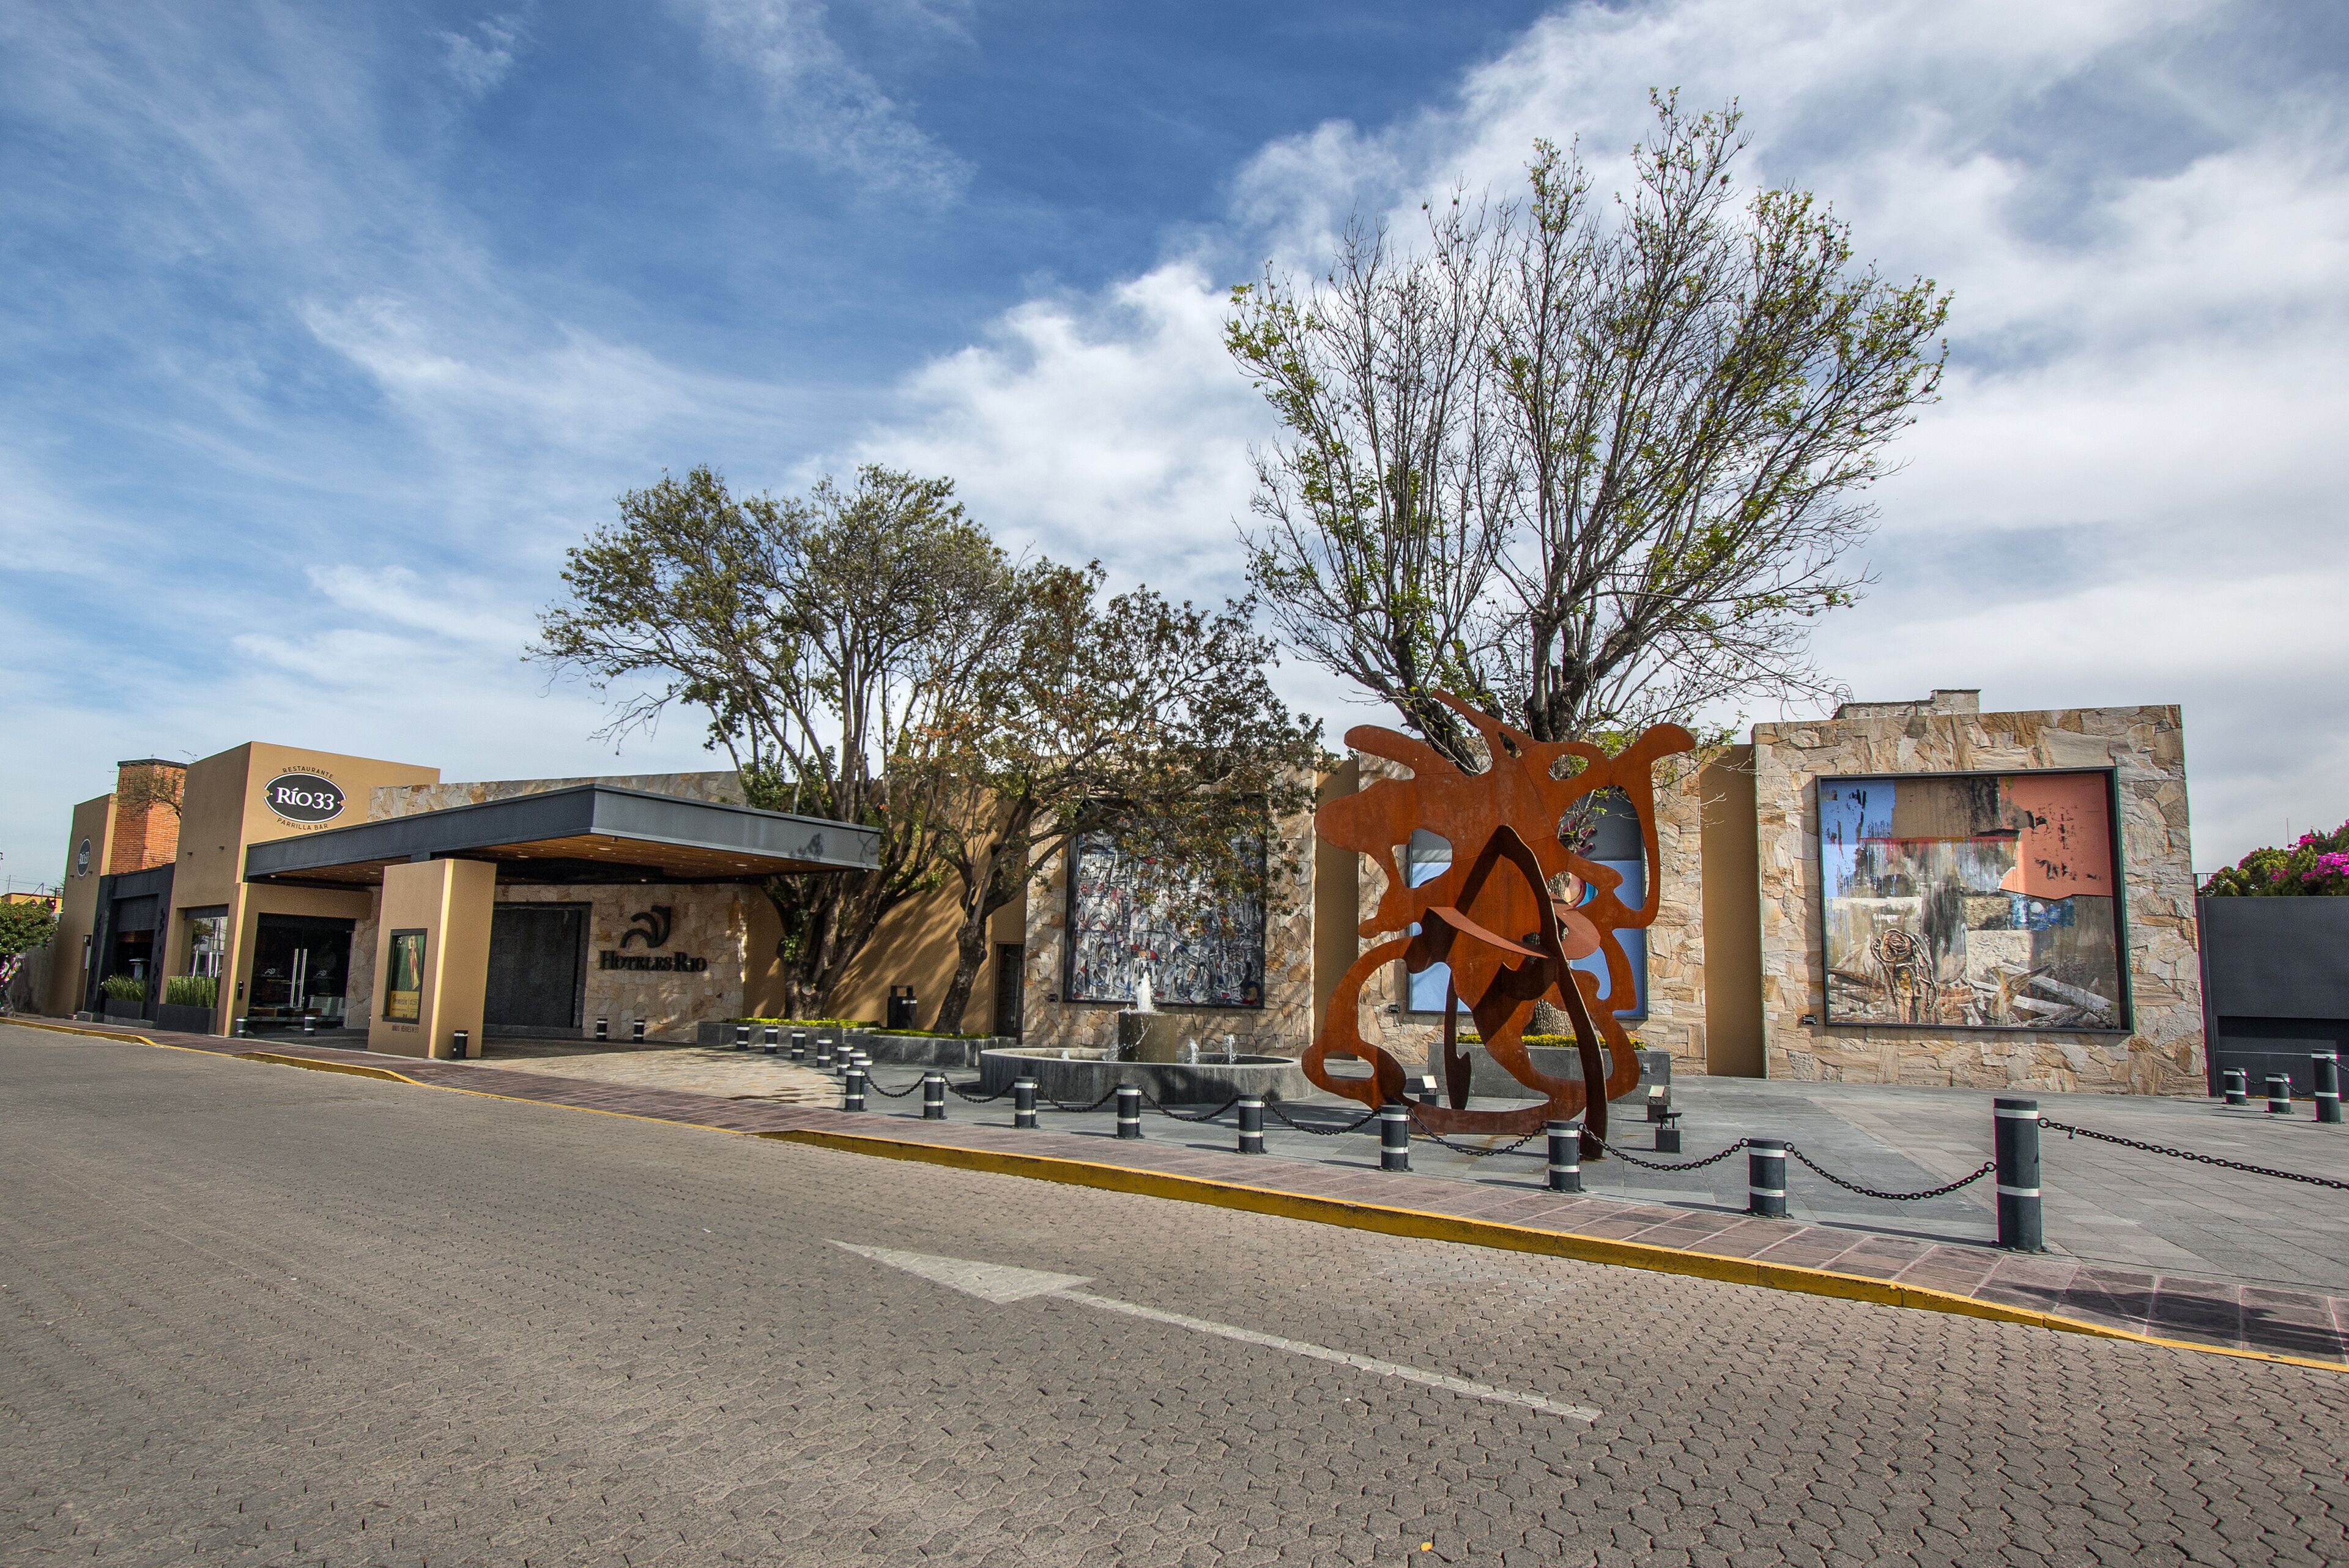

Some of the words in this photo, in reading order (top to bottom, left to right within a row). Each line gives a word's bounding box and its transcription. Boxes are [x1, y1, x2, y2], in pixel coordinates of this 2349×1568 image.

[283, 766, 333, 779] RESTAURANTE
[277, 817, 311, 830] PARRILLA
[599, 950, 672, 971] HOTELES
[673, 952, 708, 972] RIO
